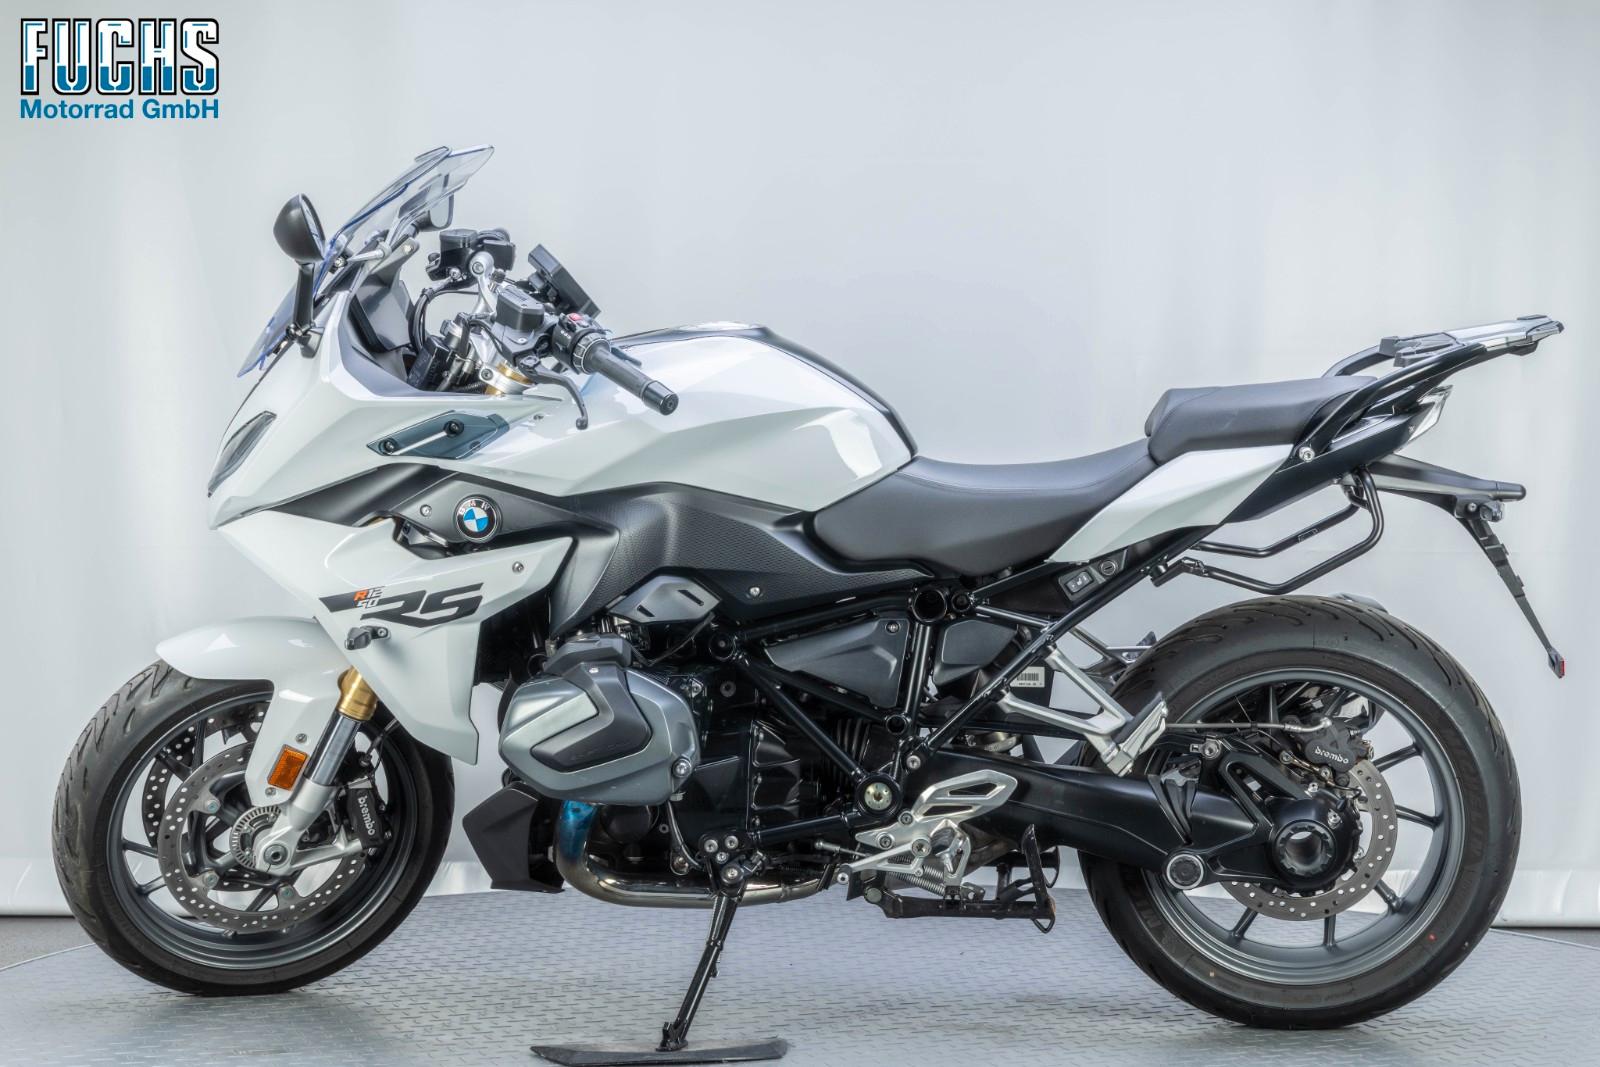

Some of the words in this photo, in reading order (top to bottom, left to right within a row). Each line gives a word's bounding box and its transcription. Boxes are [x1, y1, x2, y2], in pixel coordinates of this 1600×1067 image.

[458, 500, 491, 515] BMW
[318, 582, 484, 628] RS
[1314, 745, 1349, 764] brembo
[358, 795, 376, 836] brembo
